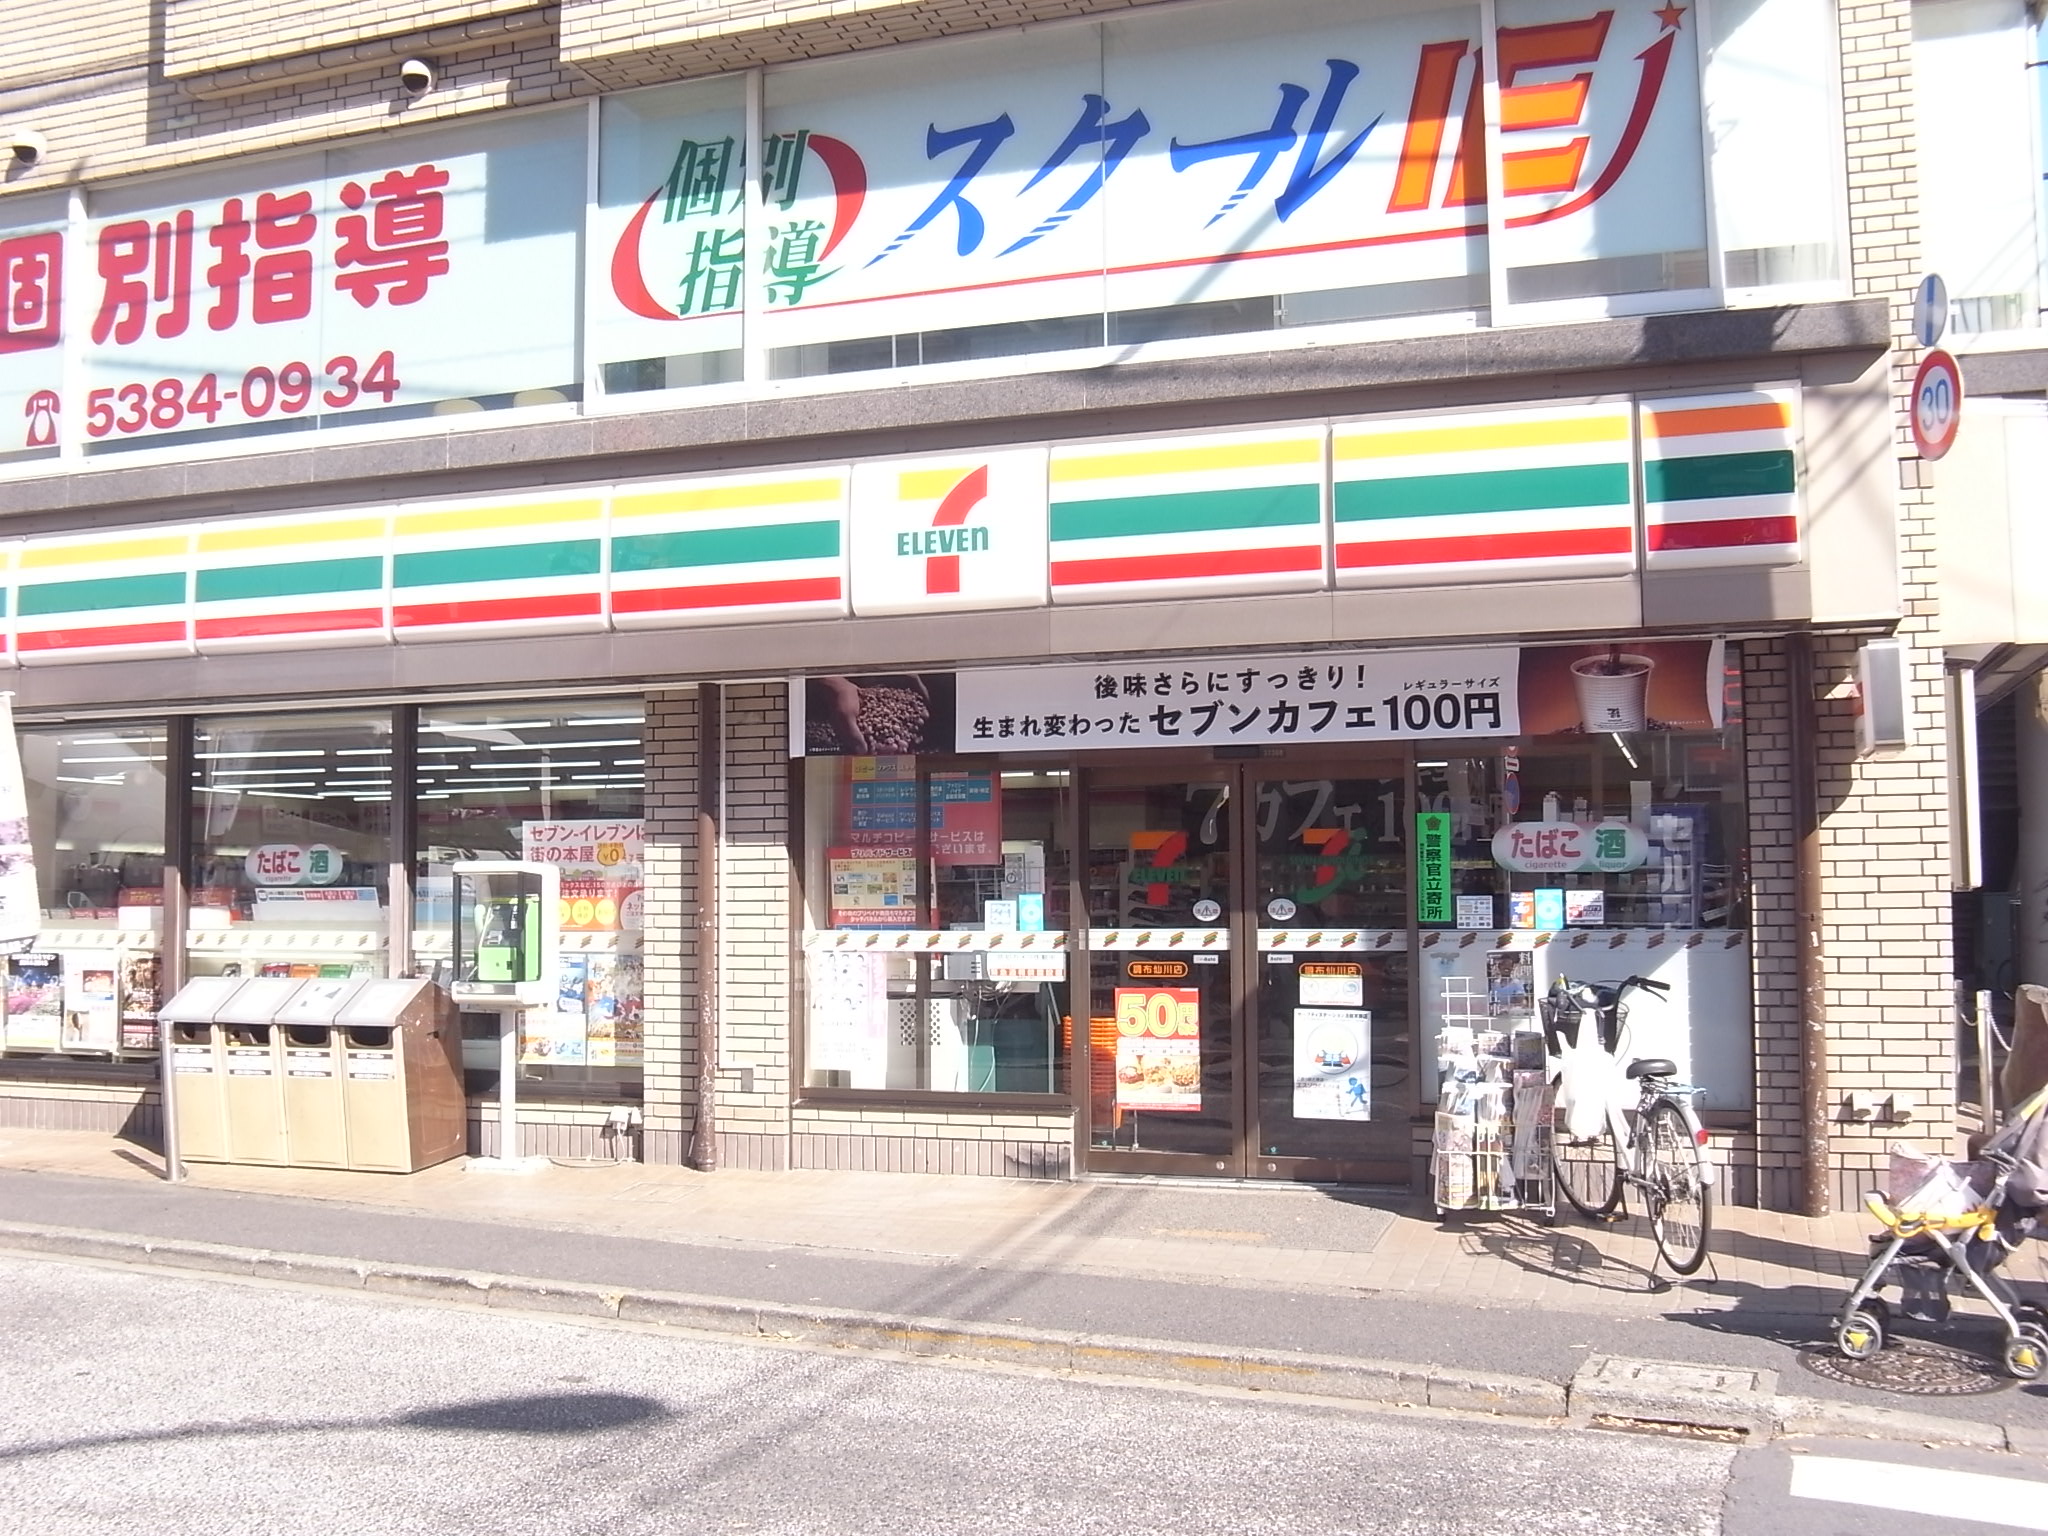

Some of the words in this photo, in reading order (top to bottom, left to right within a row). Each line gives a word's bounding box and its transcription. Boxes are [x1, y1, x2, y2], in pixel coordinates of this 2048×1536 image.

[664, 130, 811, 224] 個別
[679, 219, 843, 315] 指導
[87, 350, 400, 437] 5384-0934
[1921, 378, 1950, 431] 30
[1094, 663, 1366, 699] 後味さらにすっきり！
[1403, 677, 1500, 691] レギュラーサイズ
[530, 846, 594, 863] 街の本屋
[1511, 828, 1581, 859] たばこ
[1596, 829, 1626, 859] 酒
[257, 850, 300, 874] たばこ
[309, 850, 329, 873] 酒
[1425, 834, 1443, 919] 警察官立寄所
[1525, 860, 1567, 869] cigarette
[1600, 860, 1627, 870] liquor
[1132, 964, 1183, 975] 調布仙川店
